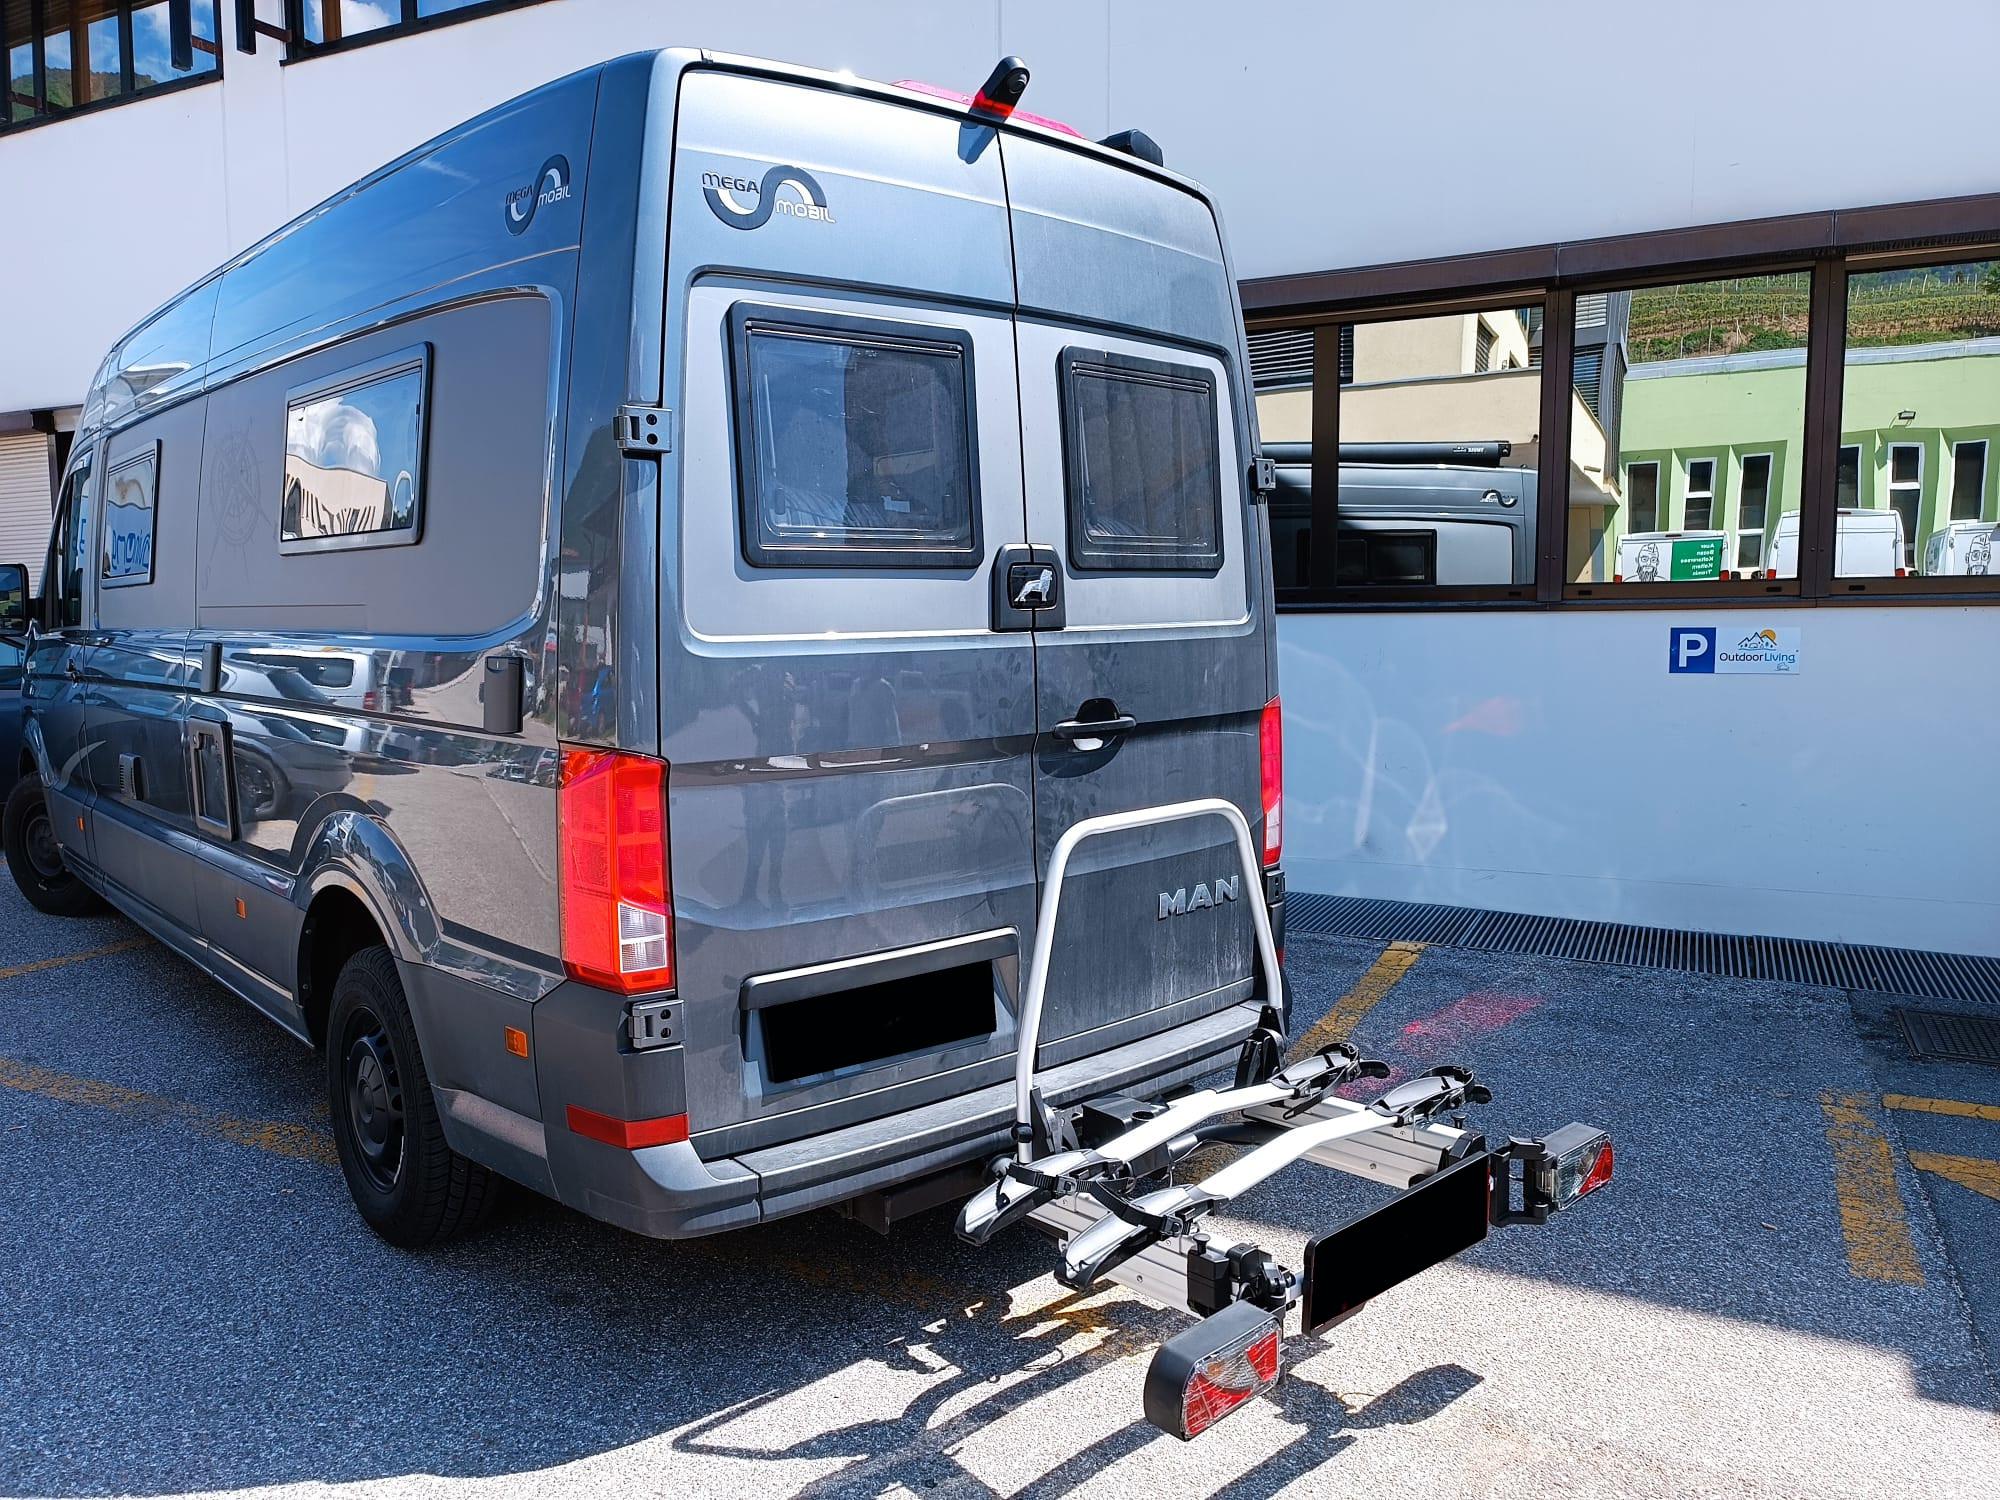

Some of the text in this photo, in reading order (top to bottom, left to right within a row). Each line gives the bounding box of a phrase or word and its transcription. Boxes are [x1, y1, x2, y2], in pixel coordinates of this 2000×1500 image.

[505, 184, 571, 208] MEGA MOBIL
[702, 172, 837, 223] MEGA MOBIL
[1678, 633, 1796, 668] P OutdoorLiving
[1158, 874, 1239, 921] MAN
